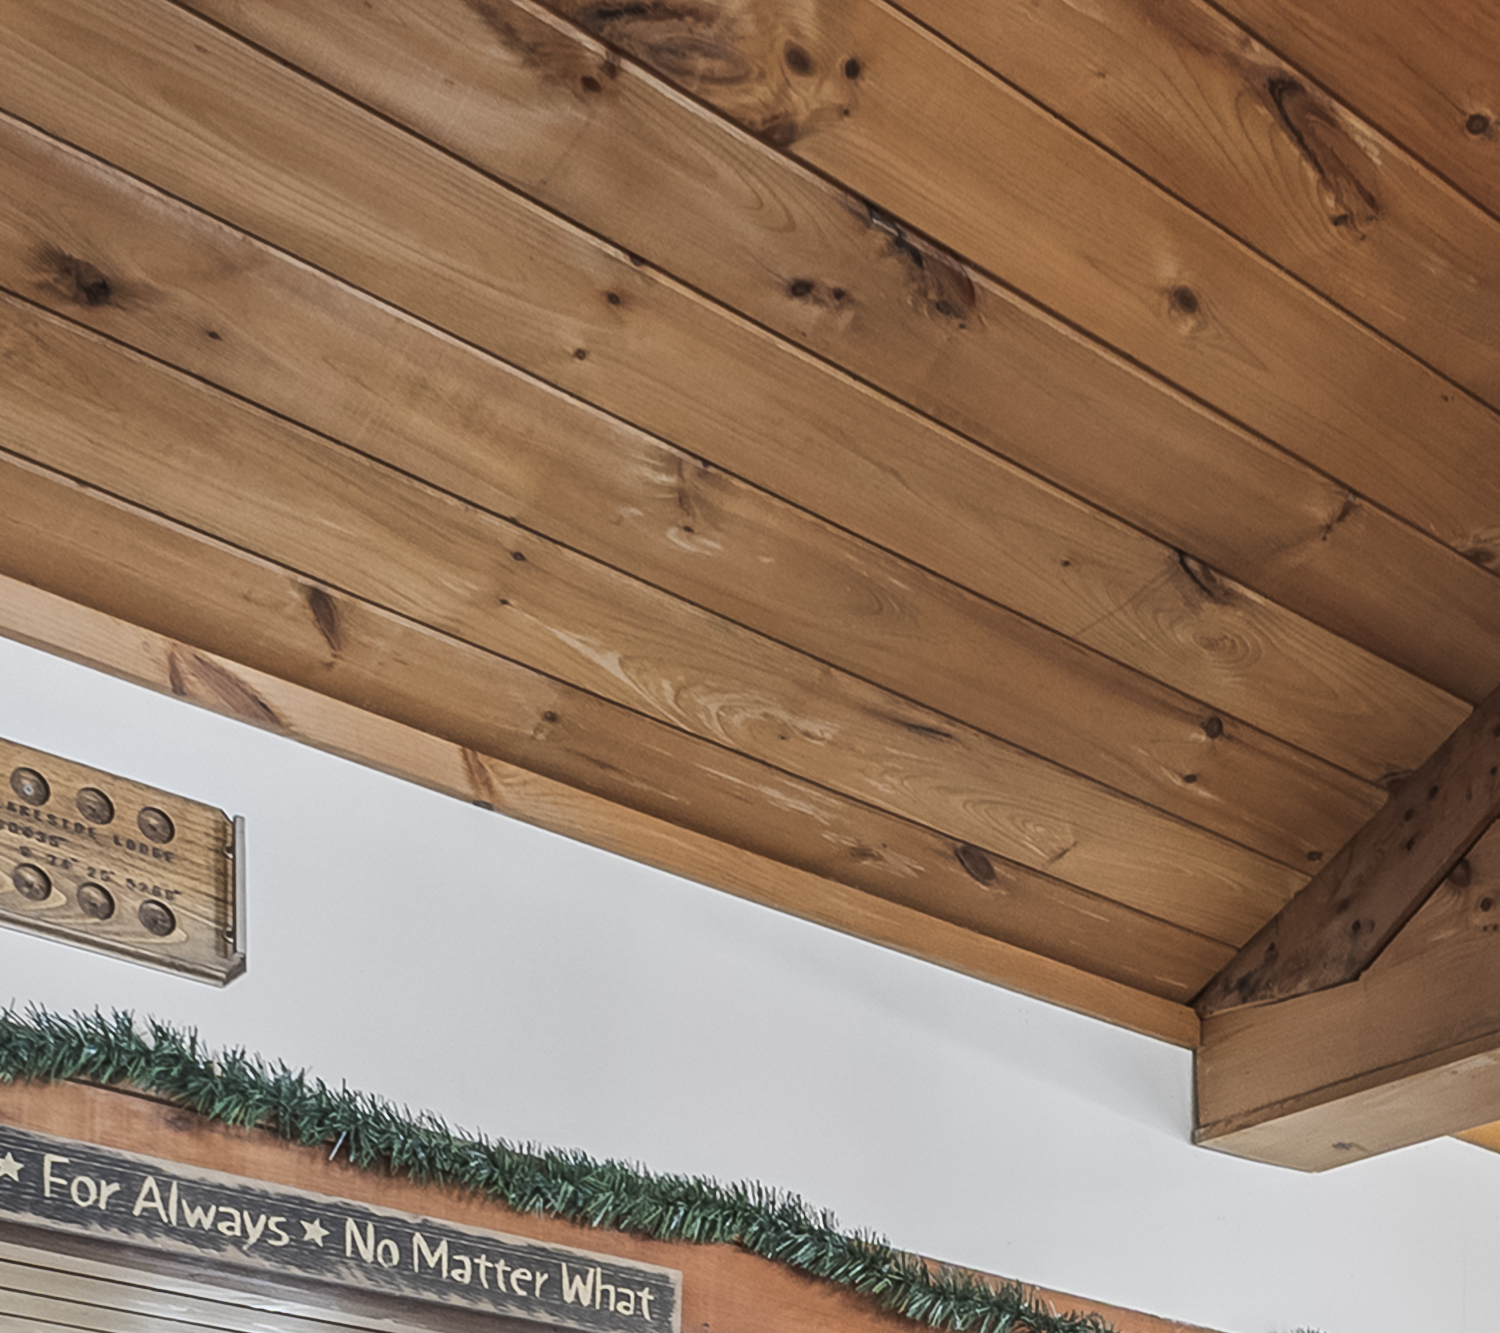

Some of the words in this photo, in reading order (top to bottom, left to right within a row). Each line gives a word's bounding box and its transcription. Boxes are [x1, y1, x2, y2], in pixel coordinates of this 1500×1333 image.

[112, 834, 177, 864] LODGE
[41, 1153, 121, 1210] For
[131, 1173, 290, 1251] Always
[344, 1217, 401, 1269] No
[411, 1230, 554, 1300] Matter
[561, 1262, 656, 1323] What
